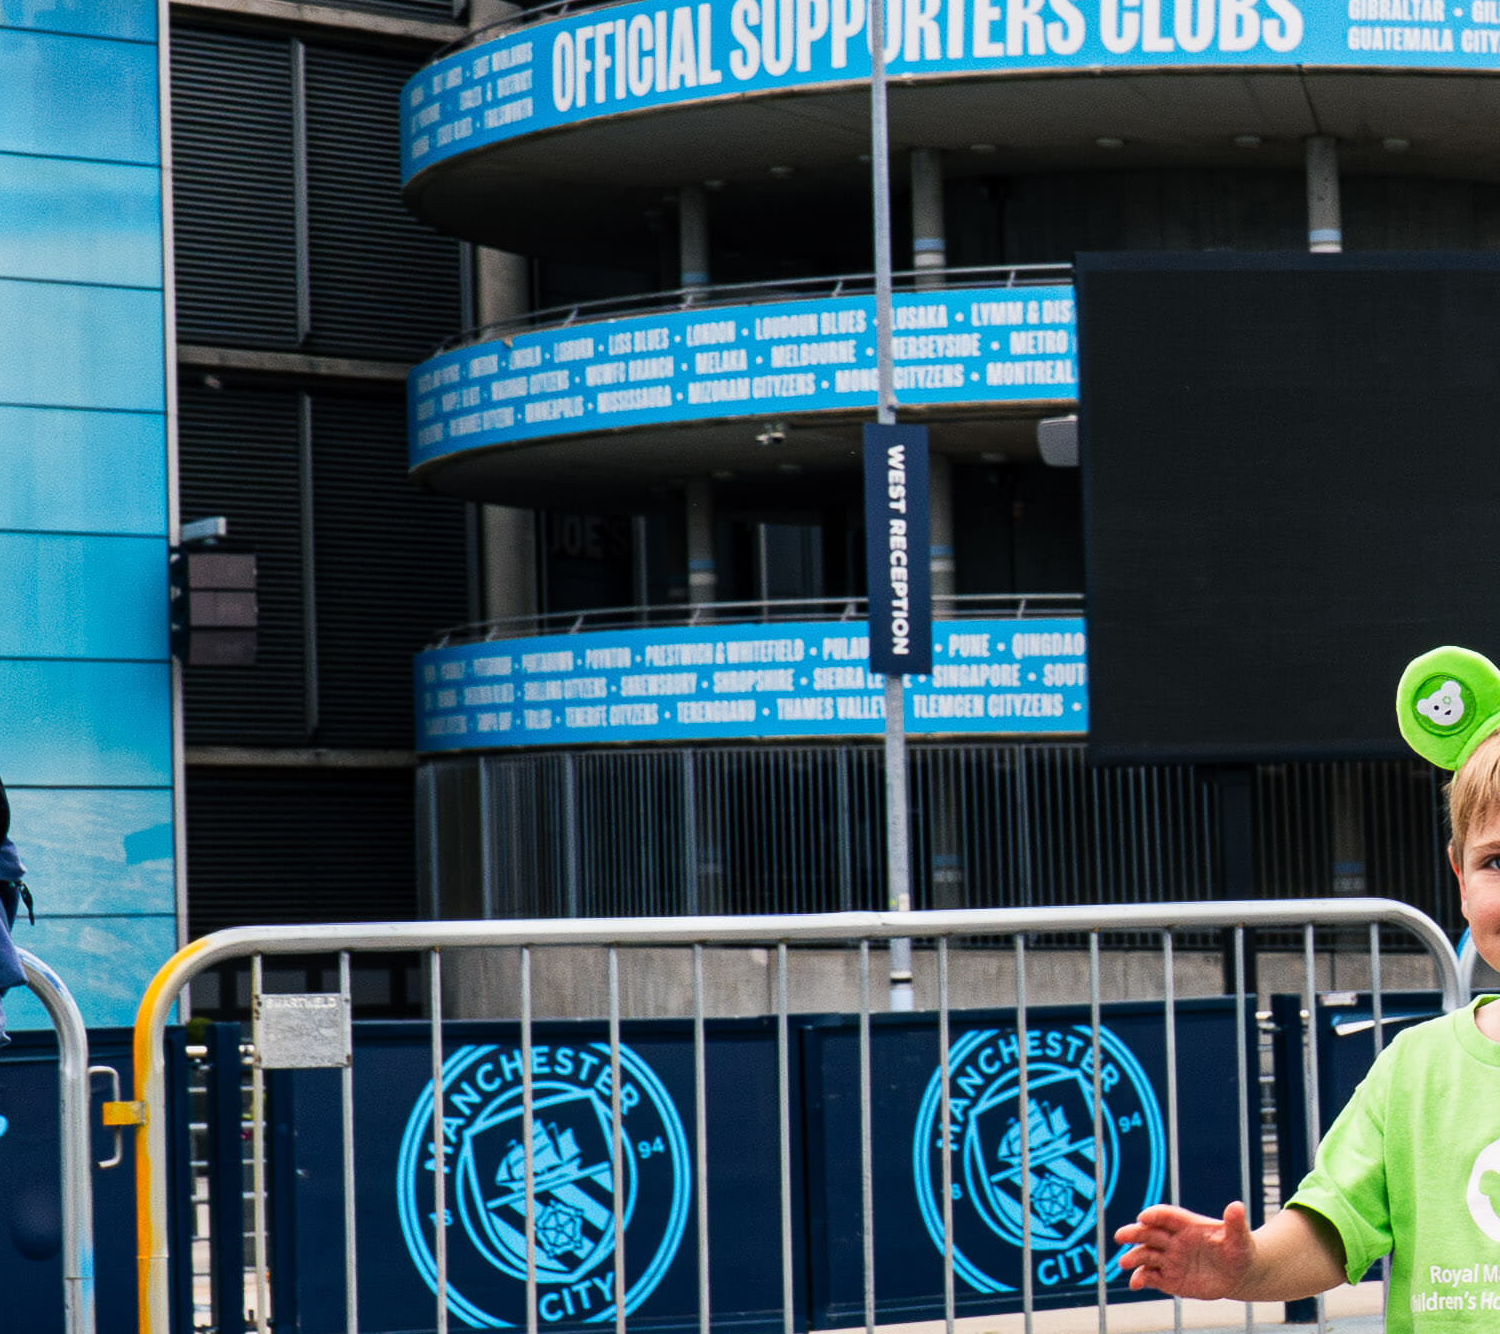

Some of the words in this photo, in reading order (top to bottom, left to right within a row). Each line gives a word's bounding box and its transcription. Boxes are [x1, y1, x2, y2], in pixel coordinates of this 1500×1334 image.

[551, 2, 722, 113] OFFICIAL
[1348, 26, 1453, 52] GUATEMALA
[687, 321, 735, 347] LONDON
[820, 310, 866, 335] BLUES
[889, 305, 948, 333] LUSAKA
[971, 302, 1023, 326] LYMM
[771, 340, 856, 367] MELBOURNE
[1010, 331, 1068, 355] METRO
[752, 373, 815, 399] CITYZENS
[891, 364, 964, 393] CITYZENS
[987, 360, 1075, 385] MONTREAL
[888, 444, 907, 515] WEST
[889, 518, 910, 656] RECEPTION
[727, 639, 804, 663] WHITEFIELD
[949, 634, 990, 657] PUNE
[1012, 633, 1085, 657] QINGDAO
[713, 669, 794, 693] SHROPSHIRE
[814, 667, 865, 690] SIERRA
[932, 664, 1020, 687] SINGAPORE
[777, 697, 833, 720] THAMES
[837, 695, 888, 720] VALLEY
[914, 695, 984, 718] TLEMCEN
[988, 694, 1063, 717] CITYZENS
[423, 1045, 641, 1175] MANCHESTER
[936, 1029, 1121, 1152] MANCHESTER
[1117, 1111, 1143, 1134] 94
[637, 1135, 666, 1160] 94
[1036, 1242, 1100, 1287] CITY
[1430, 1263, 1479, 1288] Royal
[538, 1271, 615, 1322] CITY
